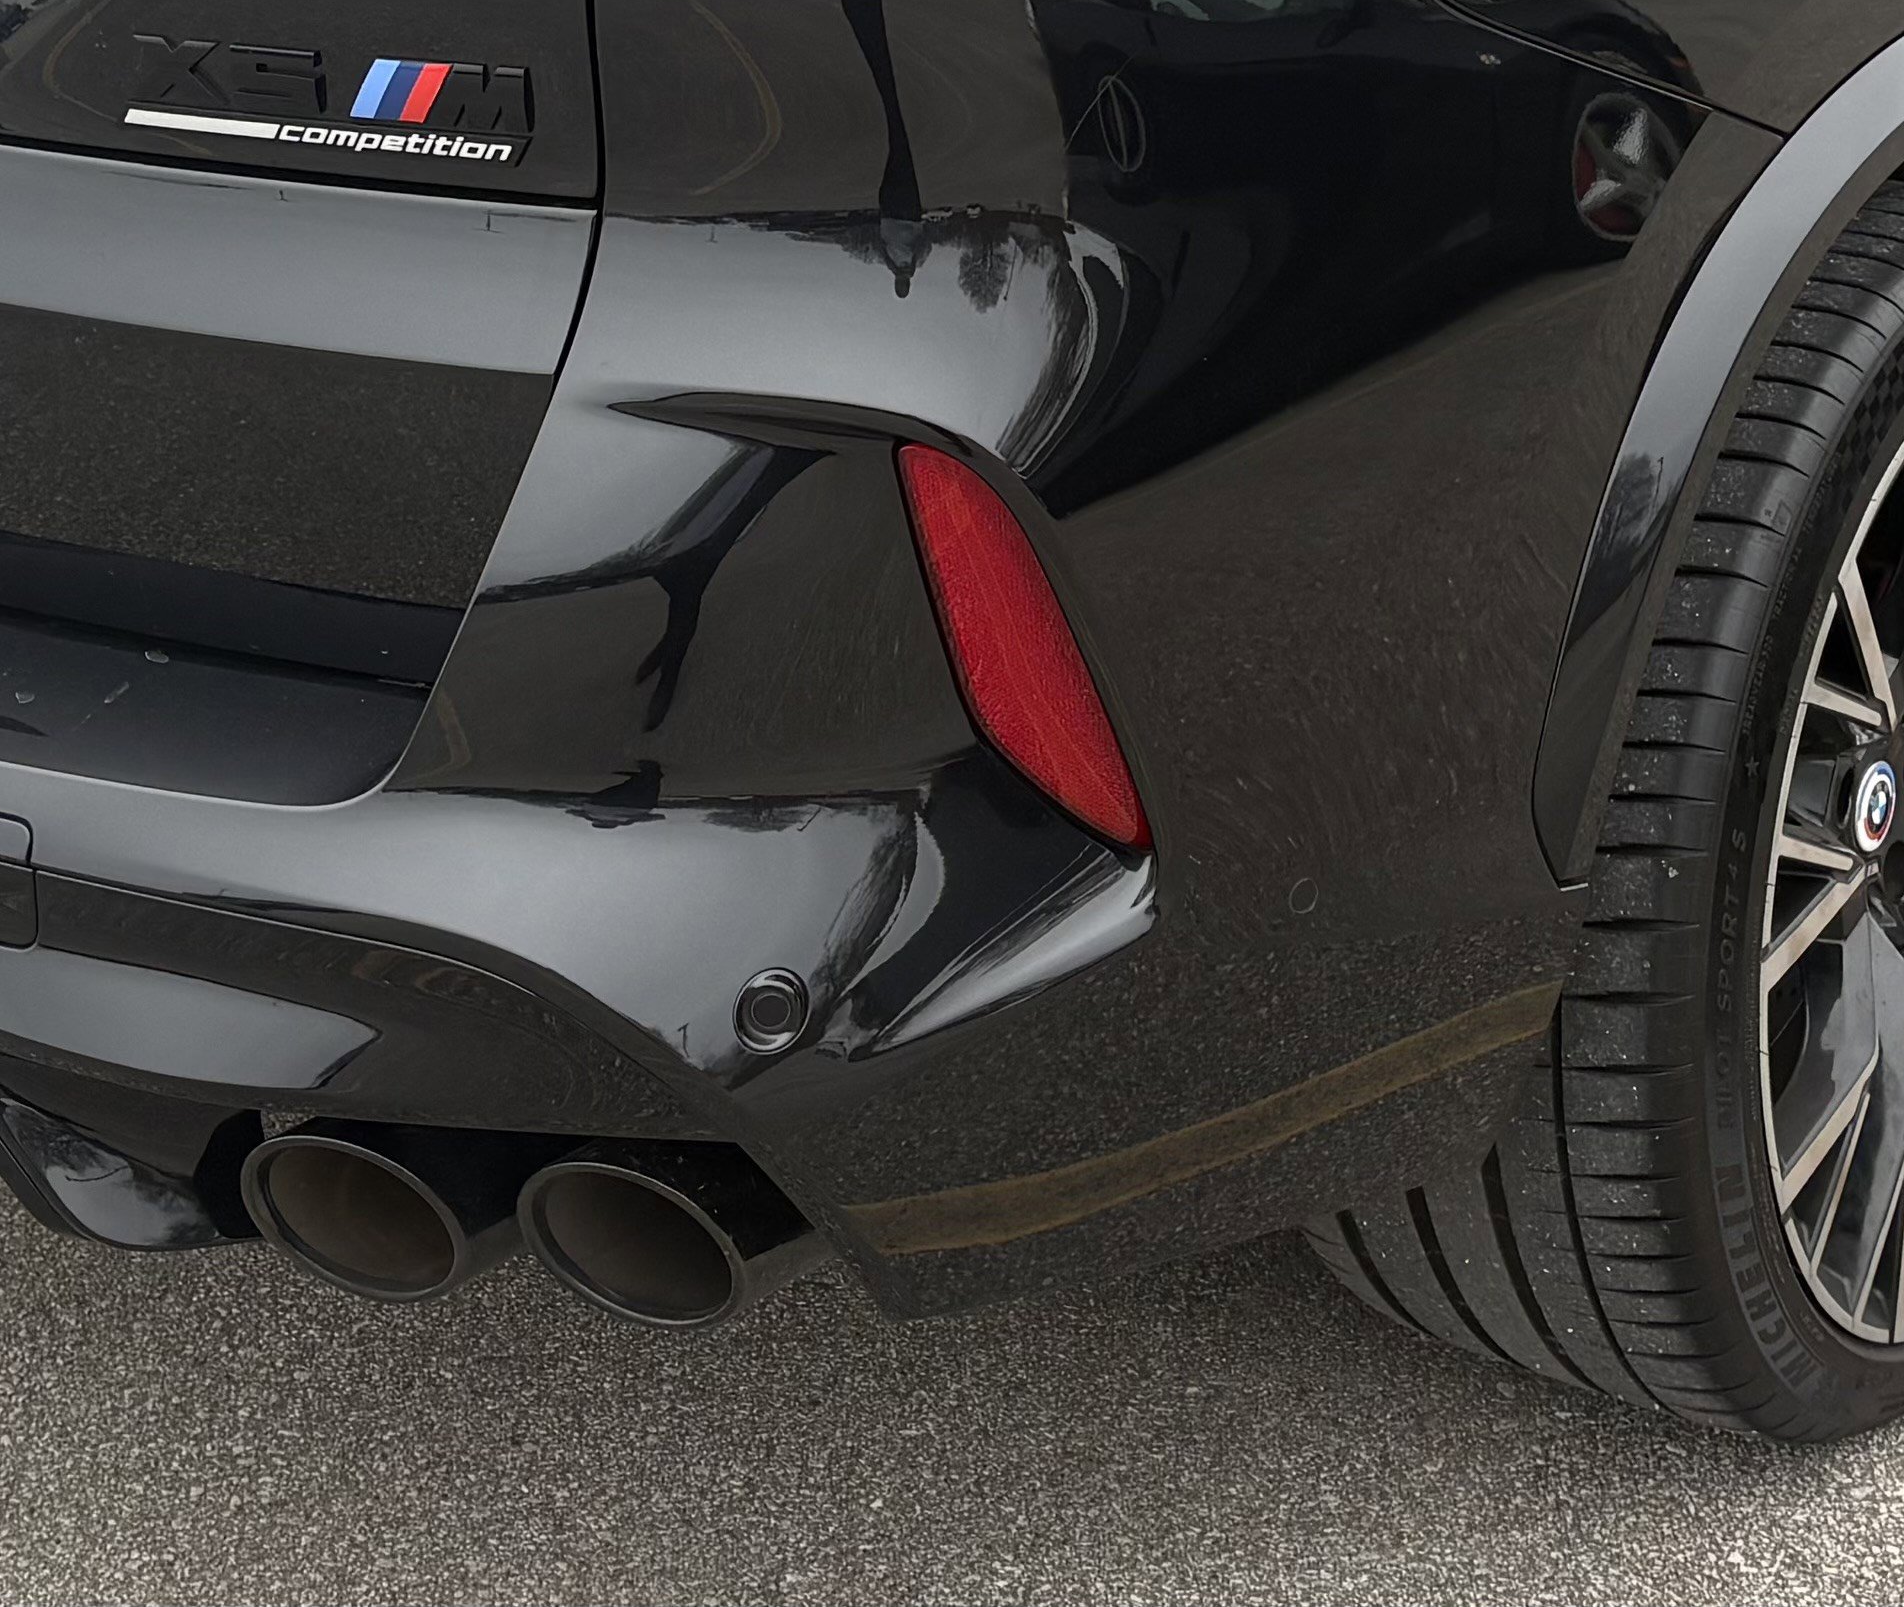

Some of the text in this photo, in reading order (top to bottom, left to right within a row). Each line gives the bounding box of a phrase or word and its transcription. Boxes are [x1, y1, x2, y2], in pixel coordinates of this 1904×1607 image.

[132, 34, 327, 114] X5
[278, 123, 513, 162] competition
[1717, 886, 1740, 1013] SPORT
[1714, 1164, 1818, 1389] MICHELIN
